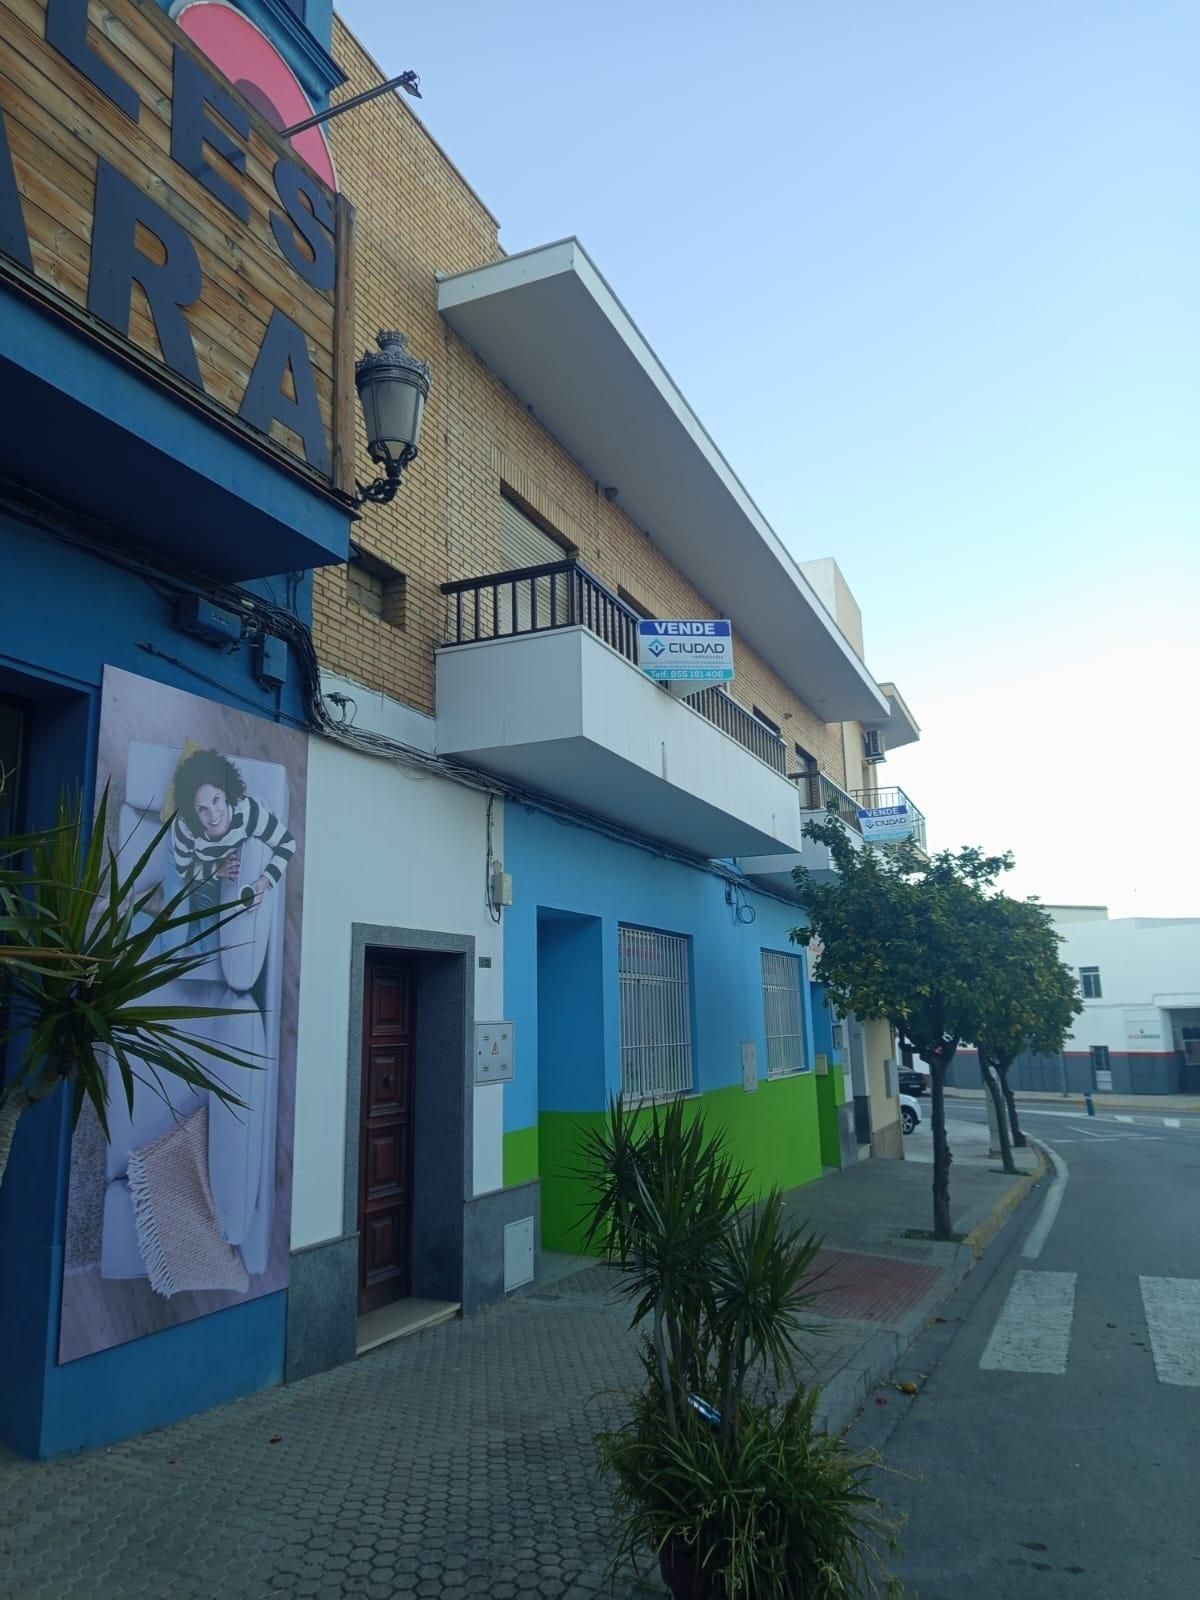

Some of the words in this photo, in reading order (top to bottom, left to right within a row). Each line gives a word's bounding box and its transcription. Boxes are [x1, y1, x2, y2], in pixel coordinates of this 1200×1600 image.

[654, 622, 716, 635] VENDE
[669, 642, 725, 654] CIUDAD
[651, 670, 668, 678] Telf:
[670, 670, 688, 678] 955
[690, 670, 704, 678] 181
[865, 808, 899, 817] VENDE
[875, 818, 906, 827] CIUDAD
